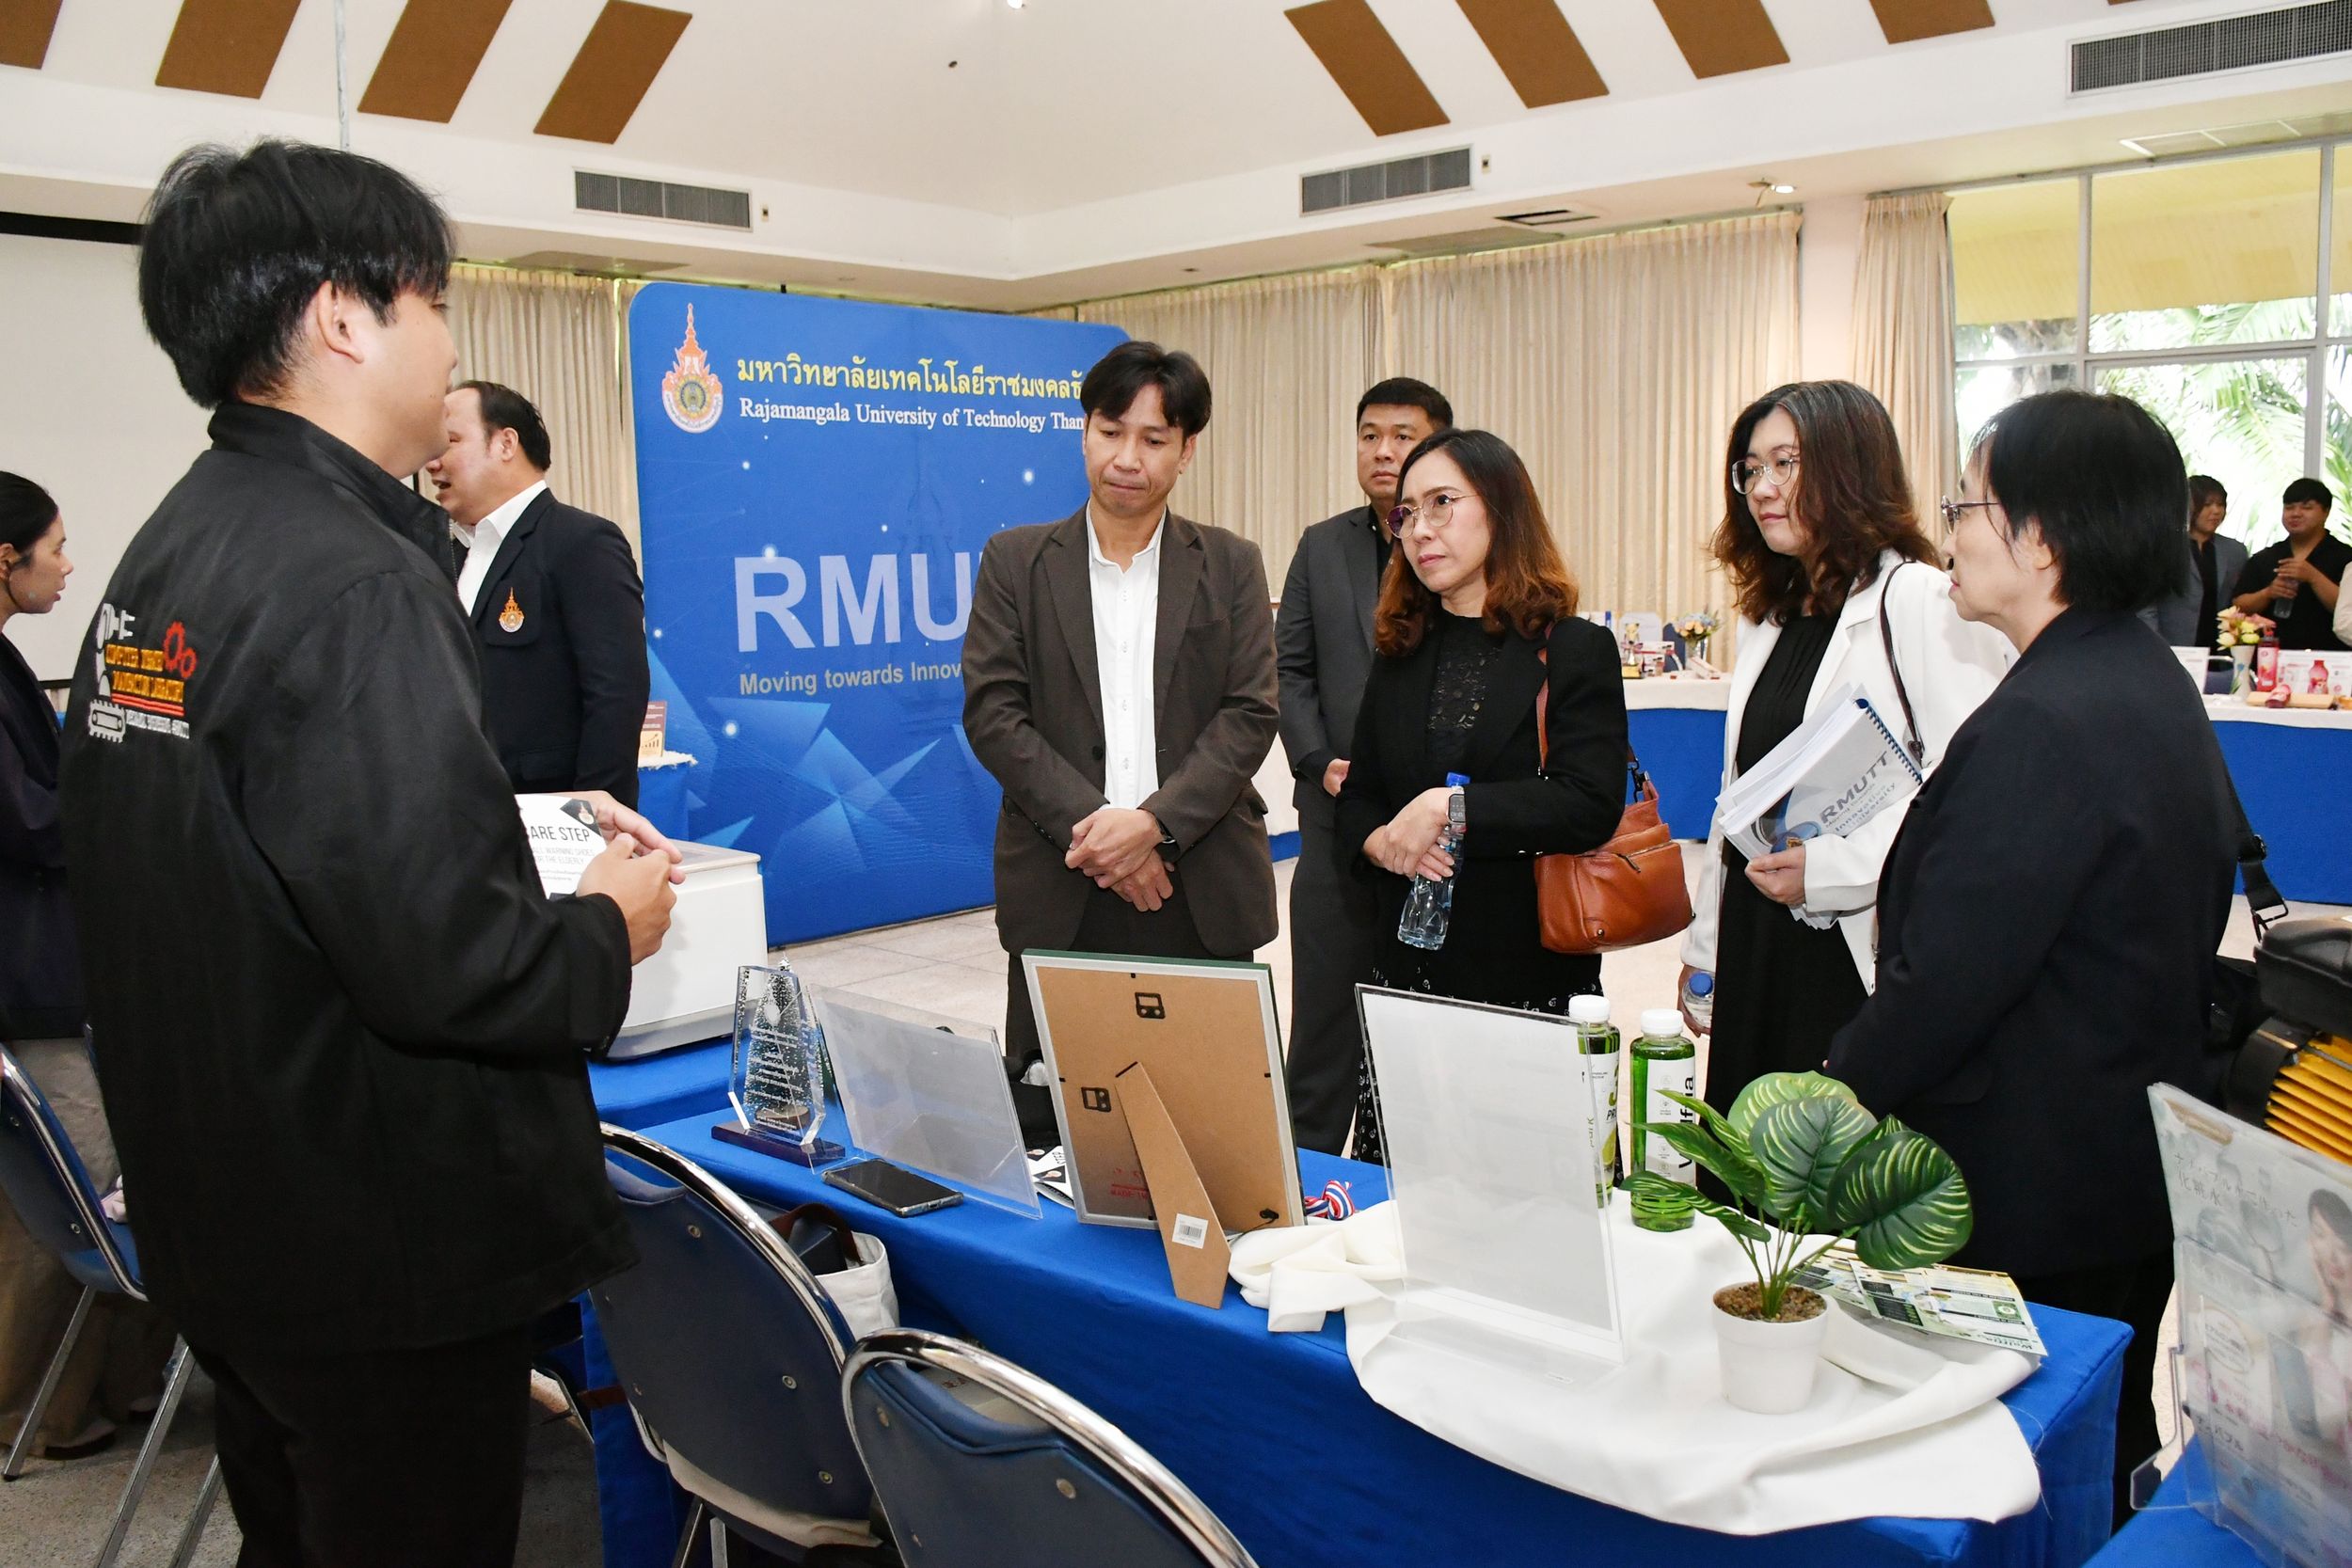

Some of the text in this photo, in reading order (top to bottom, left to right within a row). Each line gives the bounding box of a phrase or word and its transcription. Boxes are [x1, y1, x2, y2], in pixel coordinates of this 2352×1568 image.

[739, 397, 850, 425] Rajamangala
[855, 404, 937, 430] University
[943, 407, 960, 426] of
[963, 408, 1046, 433] Technology
[1050, 412, 1084, 430] Than
[734, 551, 983, 653] RMU
[739, 661, 961, 696] Moving towards Innov
[1820, 750, 1887, 824] RMUTT
[558, 826, 590, 842] STEP
